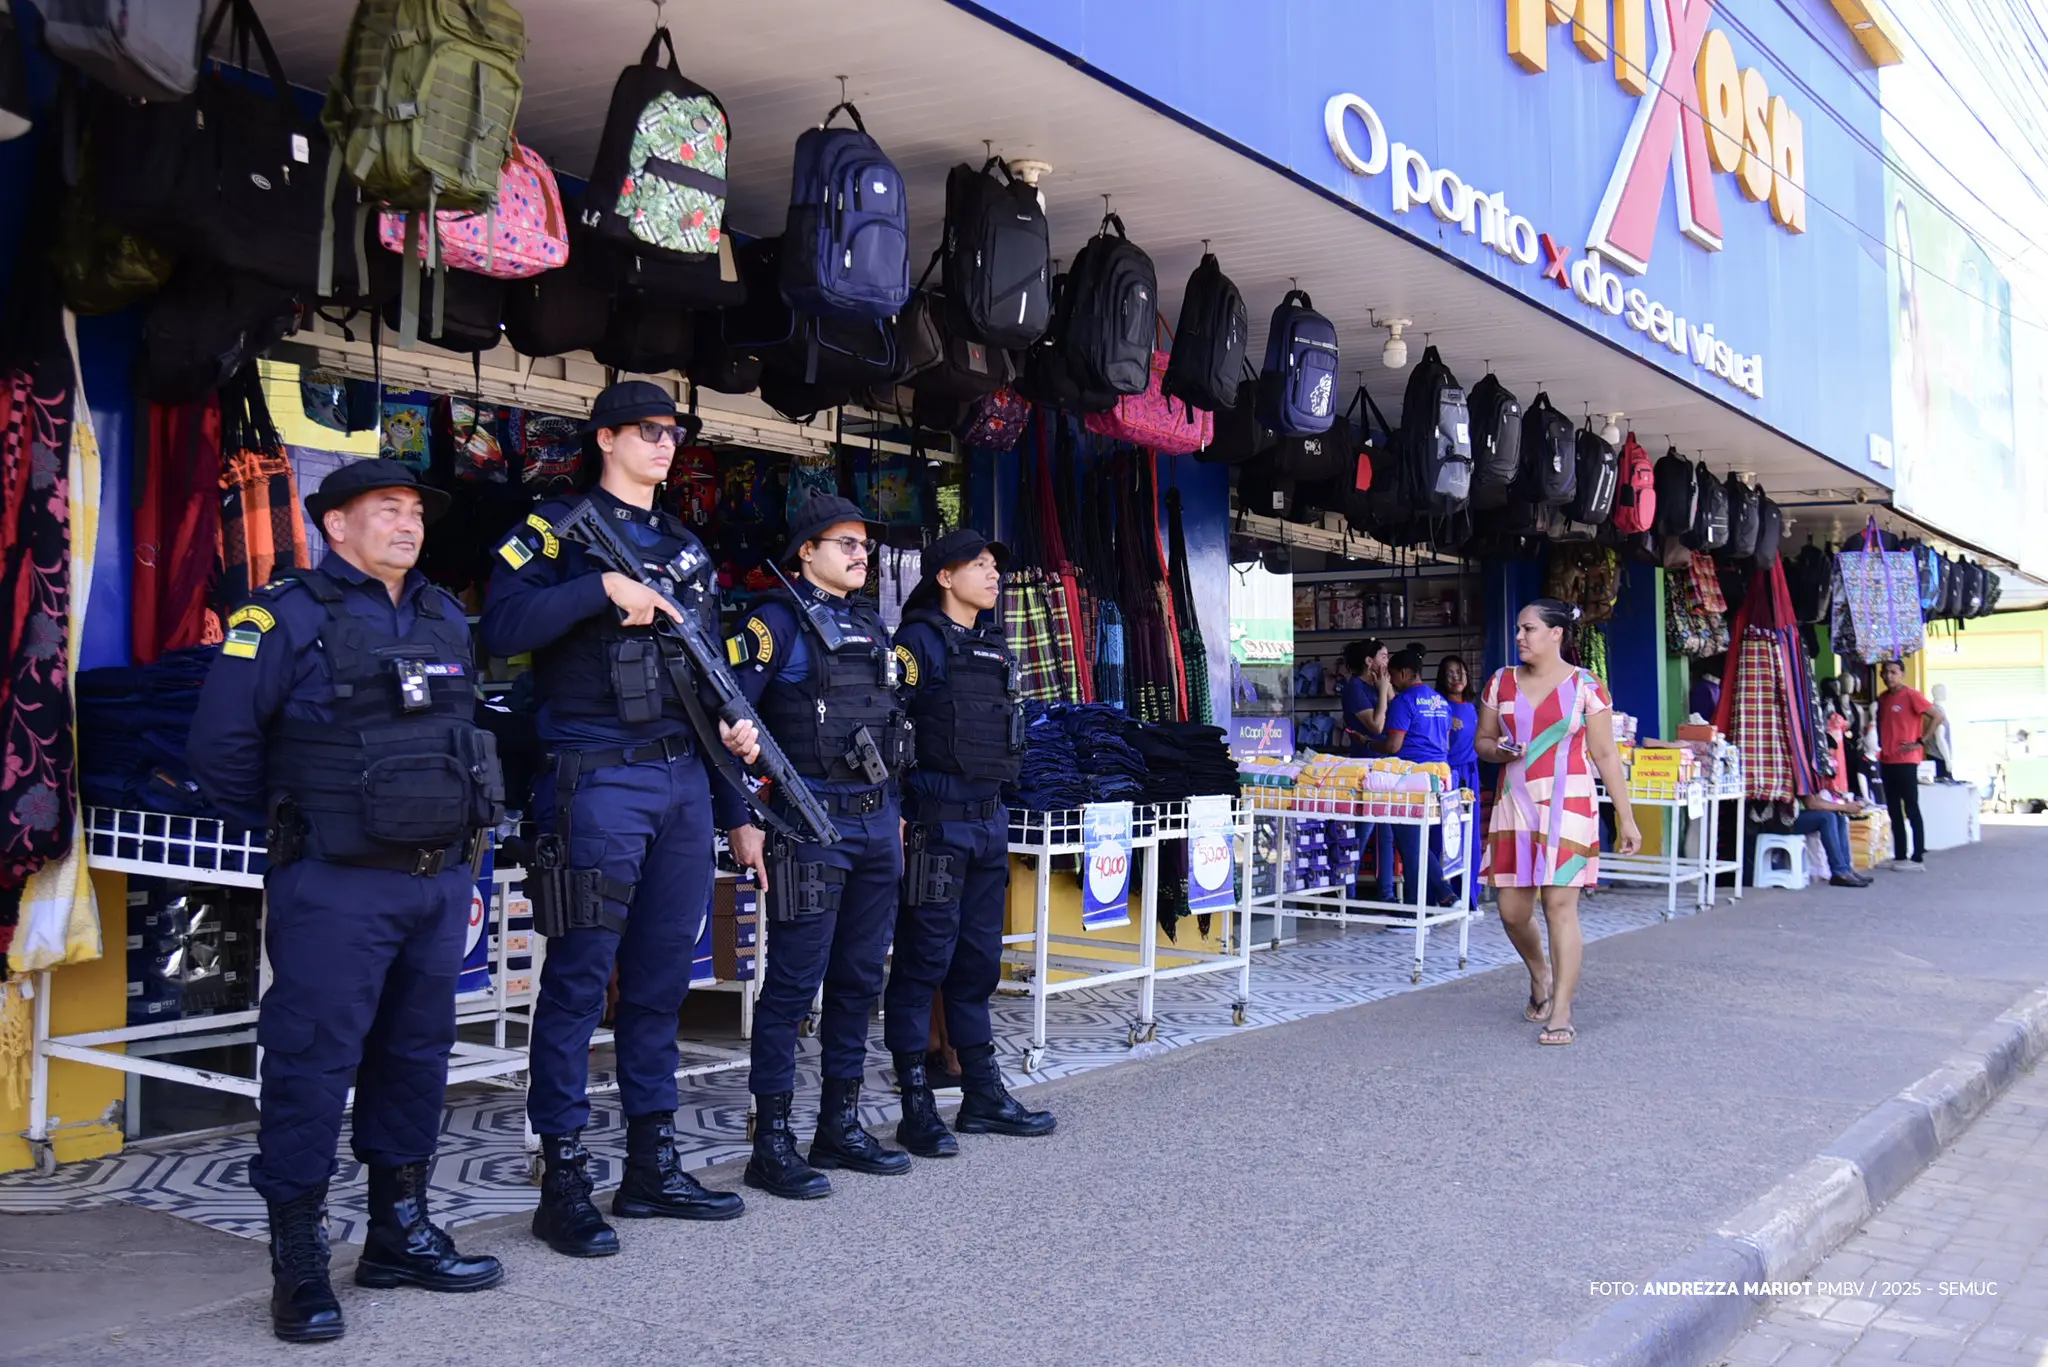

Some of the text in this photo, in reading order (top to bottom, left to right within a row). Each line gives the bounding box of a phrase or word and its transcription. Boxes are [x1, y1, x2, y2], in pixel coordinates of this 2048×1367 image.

[1324, 92, 1389, 177] O
[1391, 142, 1539, 265] ponto
[1571, 249, 1624, 316] do
[1624, 288, 1687, 355] seu
[1687, 323, 1763, 399] visual
[760, 634, 771, 658] VISTA
[896, 647, 917, 682] BOA VISTA
